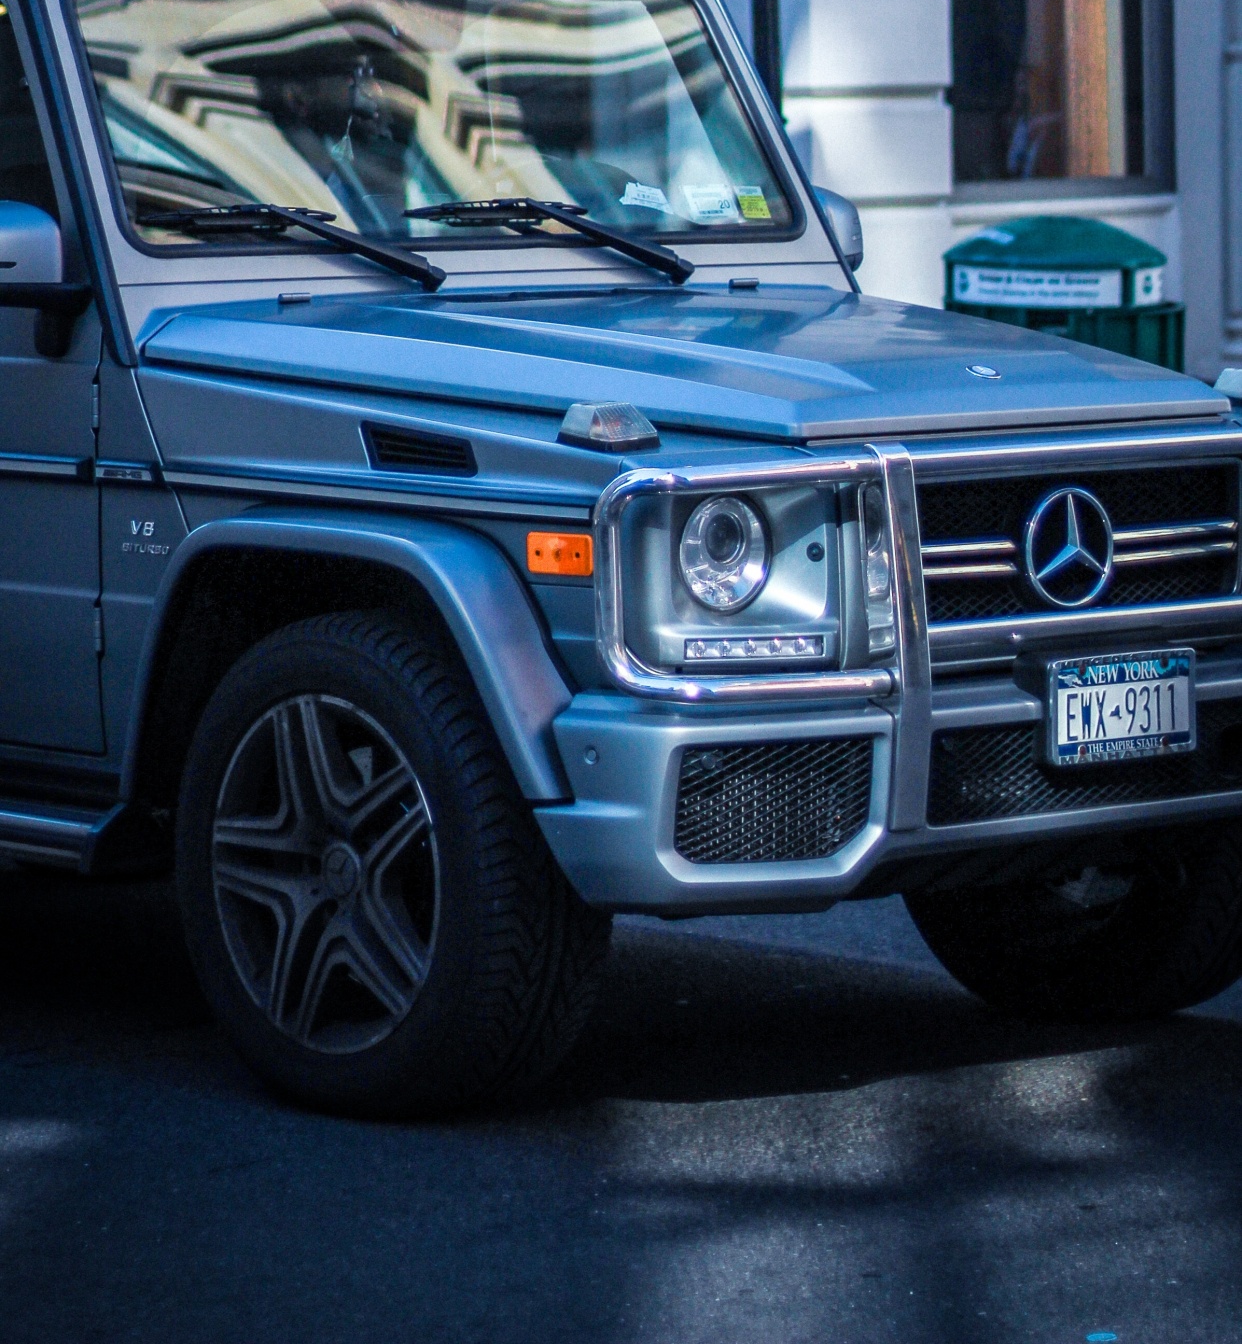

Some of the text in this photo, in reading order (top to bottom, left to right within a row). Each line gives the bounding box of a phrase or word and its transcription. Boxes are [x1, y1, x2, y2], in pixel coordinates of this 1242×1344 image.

[718, 199, 731, 209] 20
[130, 520, 155, 536] V8
[1087, 659, 1159, 685] NEW YORK
[1087, 737, 1159, 754] THE EMPIRE STATE
